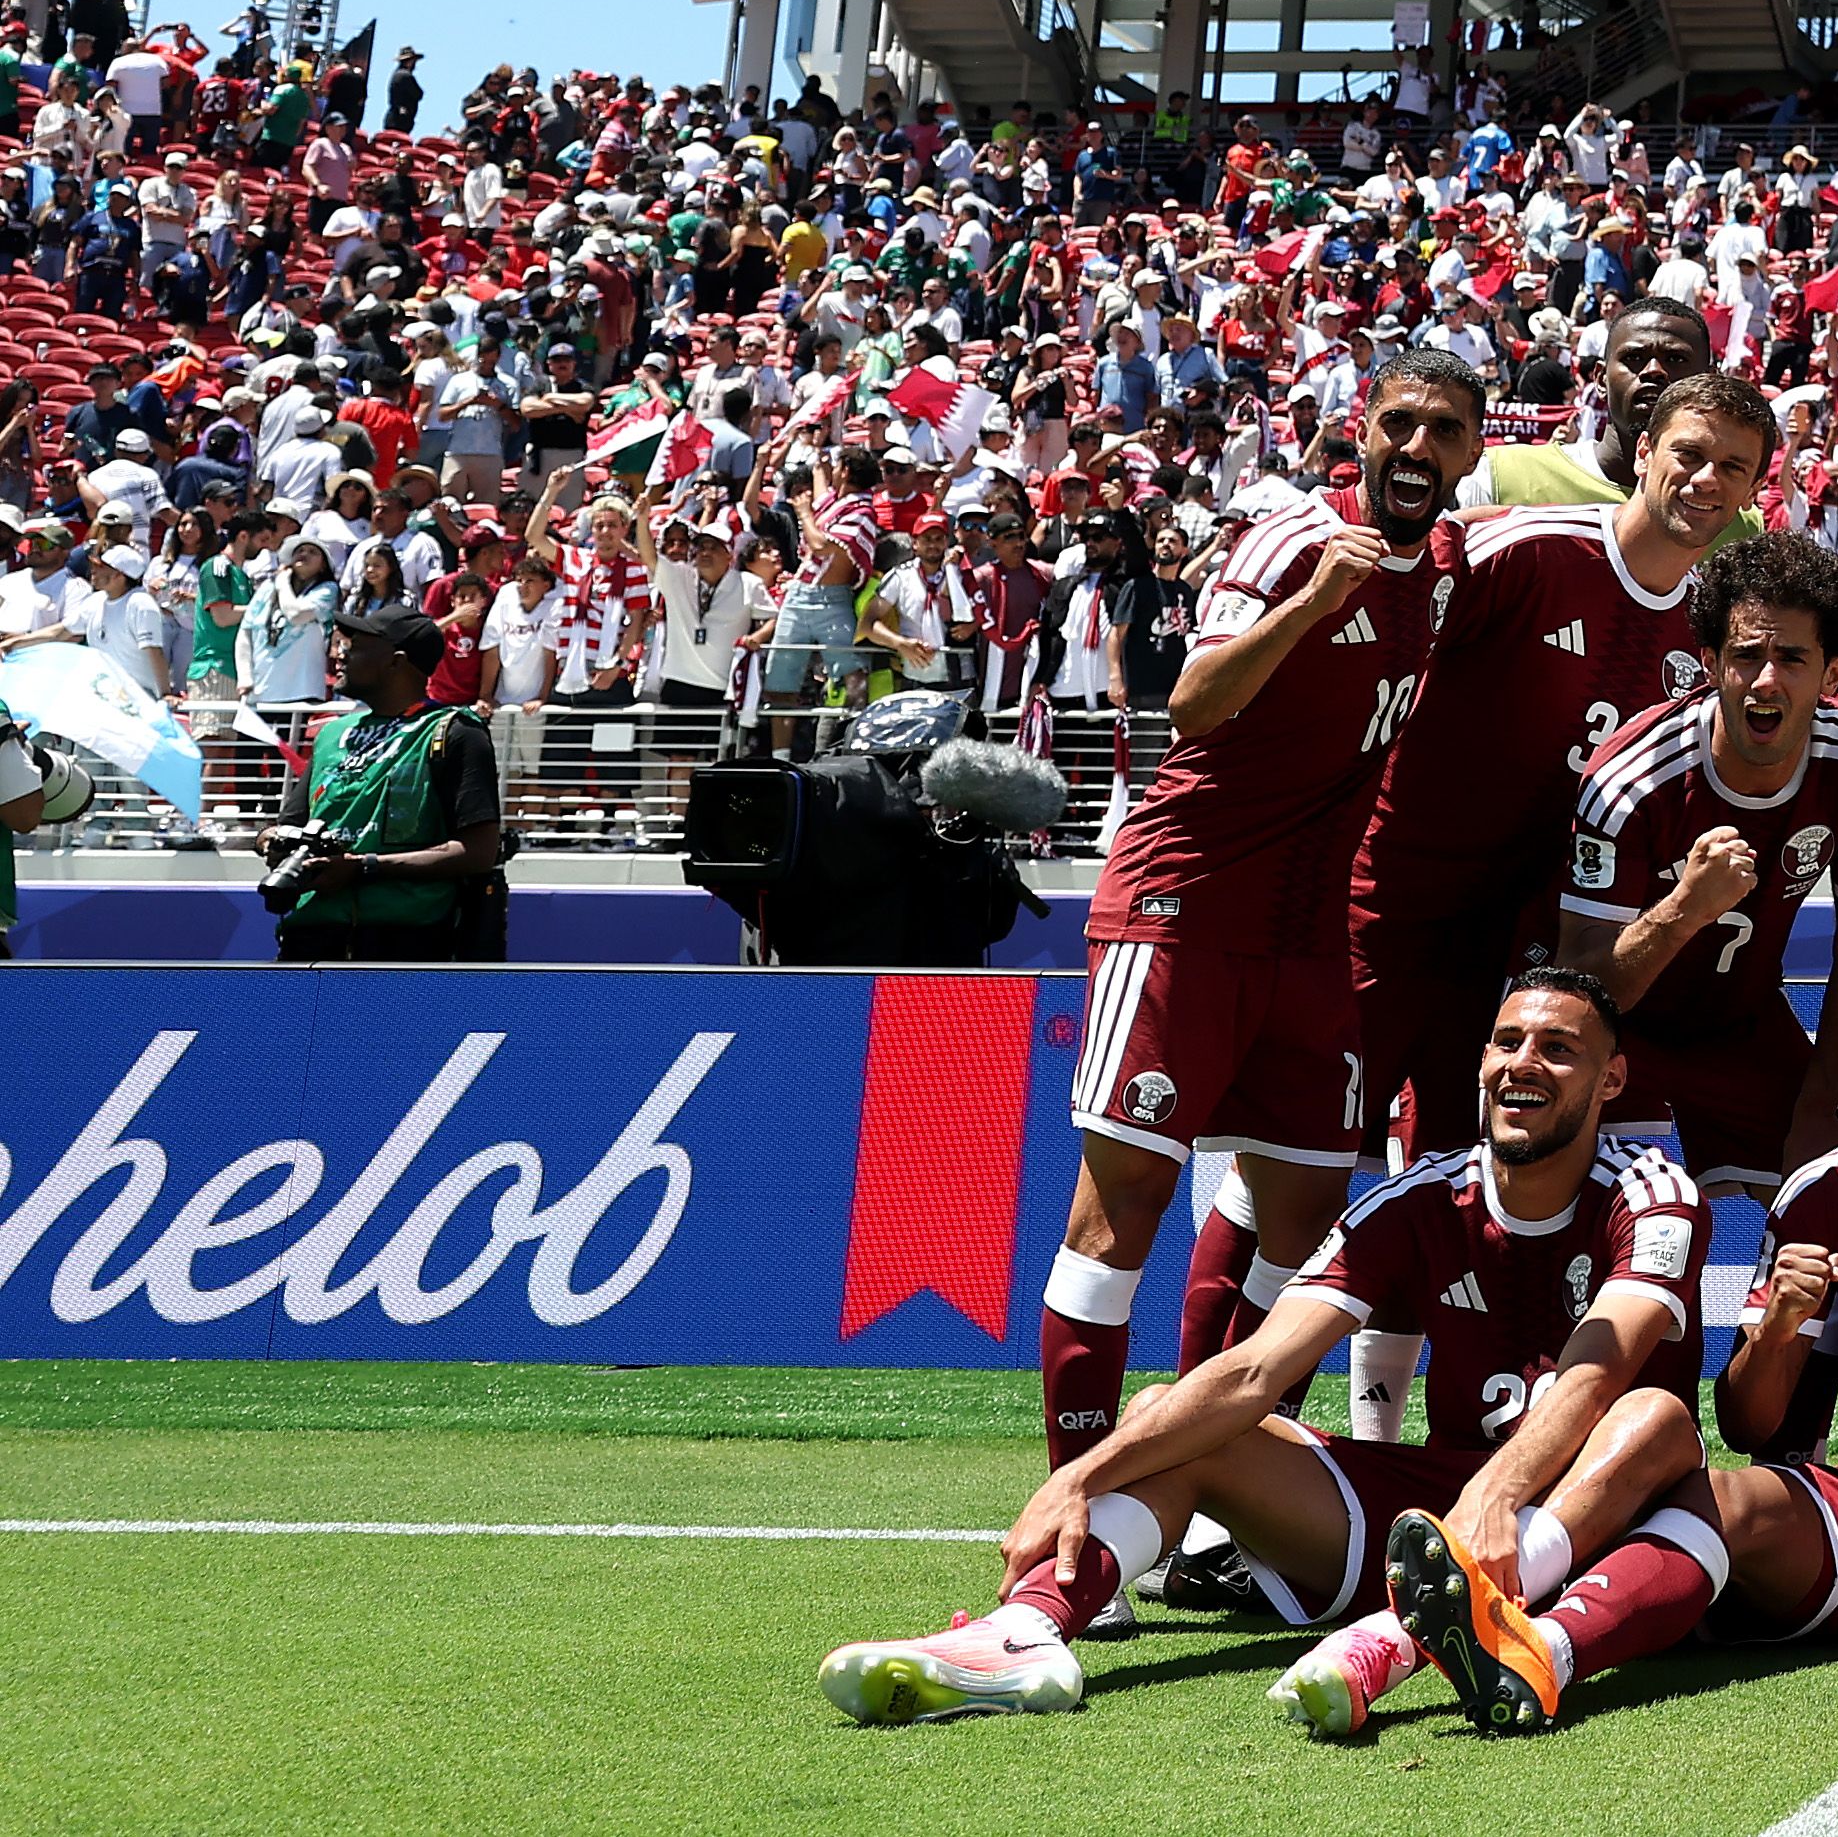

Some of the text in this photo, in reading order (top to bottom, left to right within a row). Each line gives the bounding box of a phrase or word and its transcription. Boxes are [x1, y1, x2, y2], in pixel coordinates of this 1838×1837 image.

[1473, 146, 1486, 170] 7
[1567, 701, 1619, 772] 3
[1796, 861, 1821, 877] QFA
[1716, 911, 1753, 974] 7
[1132, 1106, 1156, 1122] QFA
[0, 1030, 736, 1327] helob
[1650, 1250, 1675, 1263] PEACE
[1573, 1300, 1588, 1318] QFA
[1272, 1401, 1301, 1417] QF
[1058, 1409, 1108, 1431] QFA
